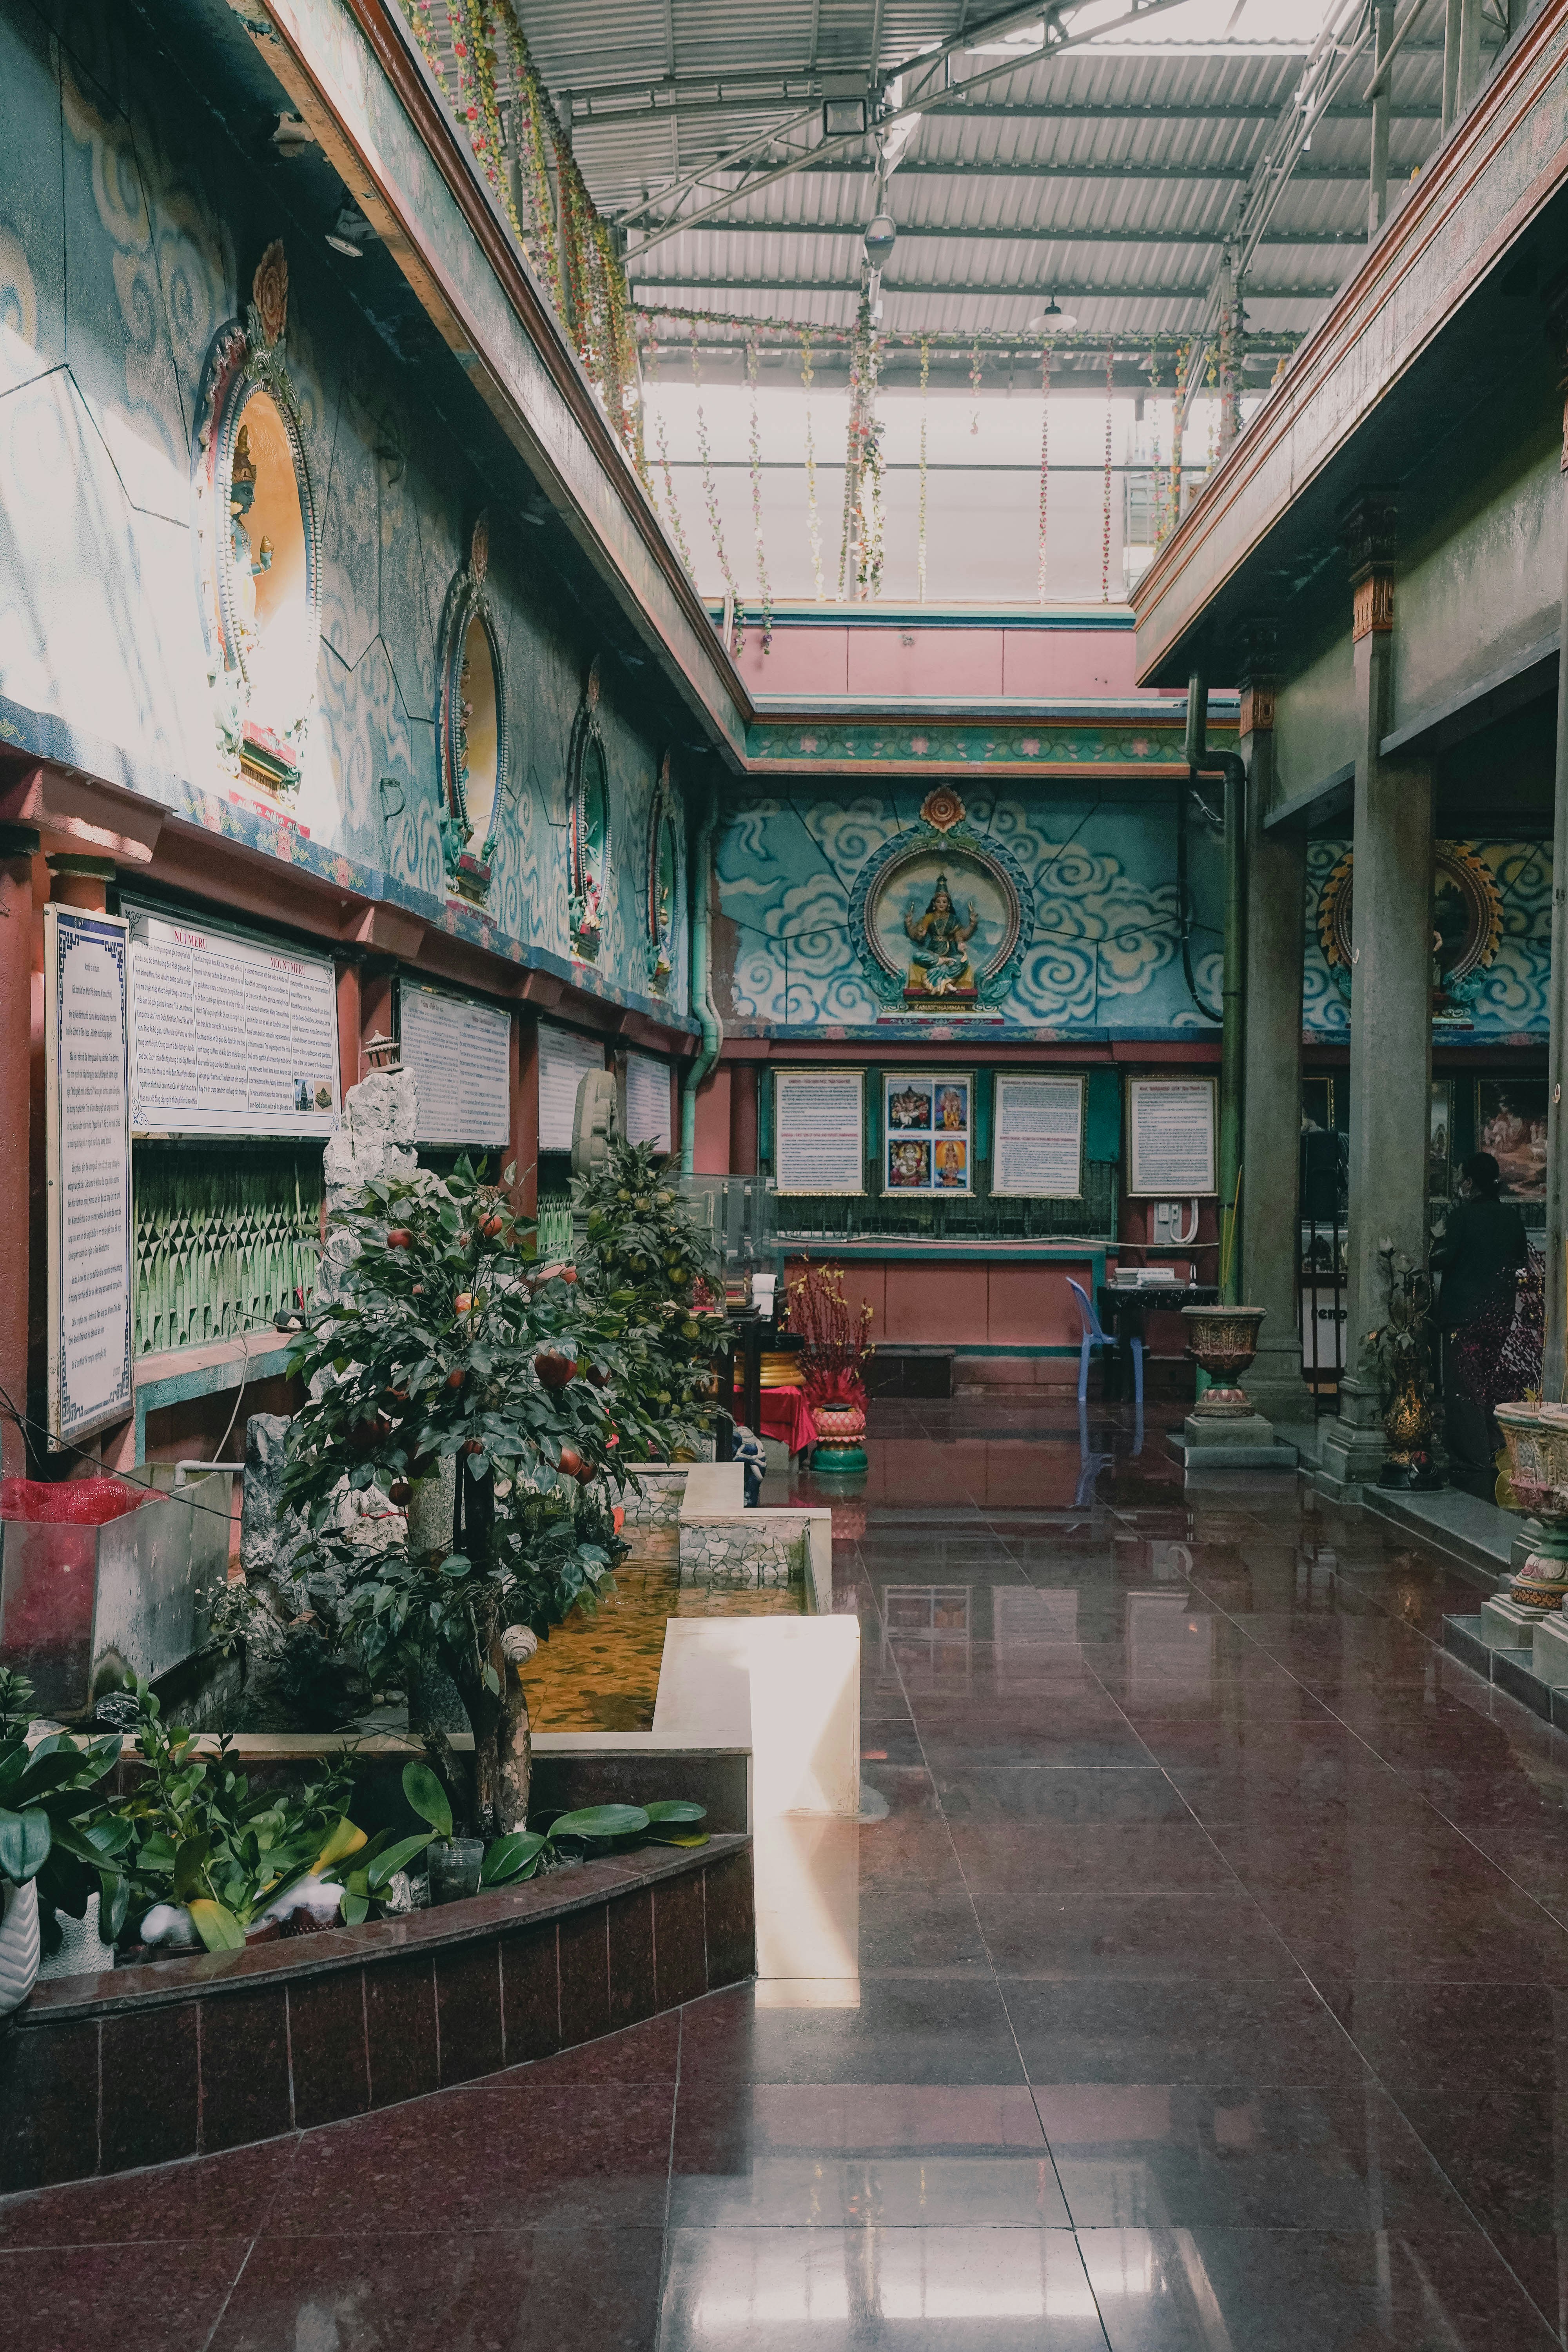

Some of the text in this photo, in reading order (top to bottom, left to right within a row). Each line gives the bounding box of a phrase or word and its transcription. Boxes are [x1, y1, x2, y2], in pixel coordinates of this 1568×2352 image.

[175, 929, 207, 949] NÚI MERU
[270, 957, 305, 975] MOUNT MERU
